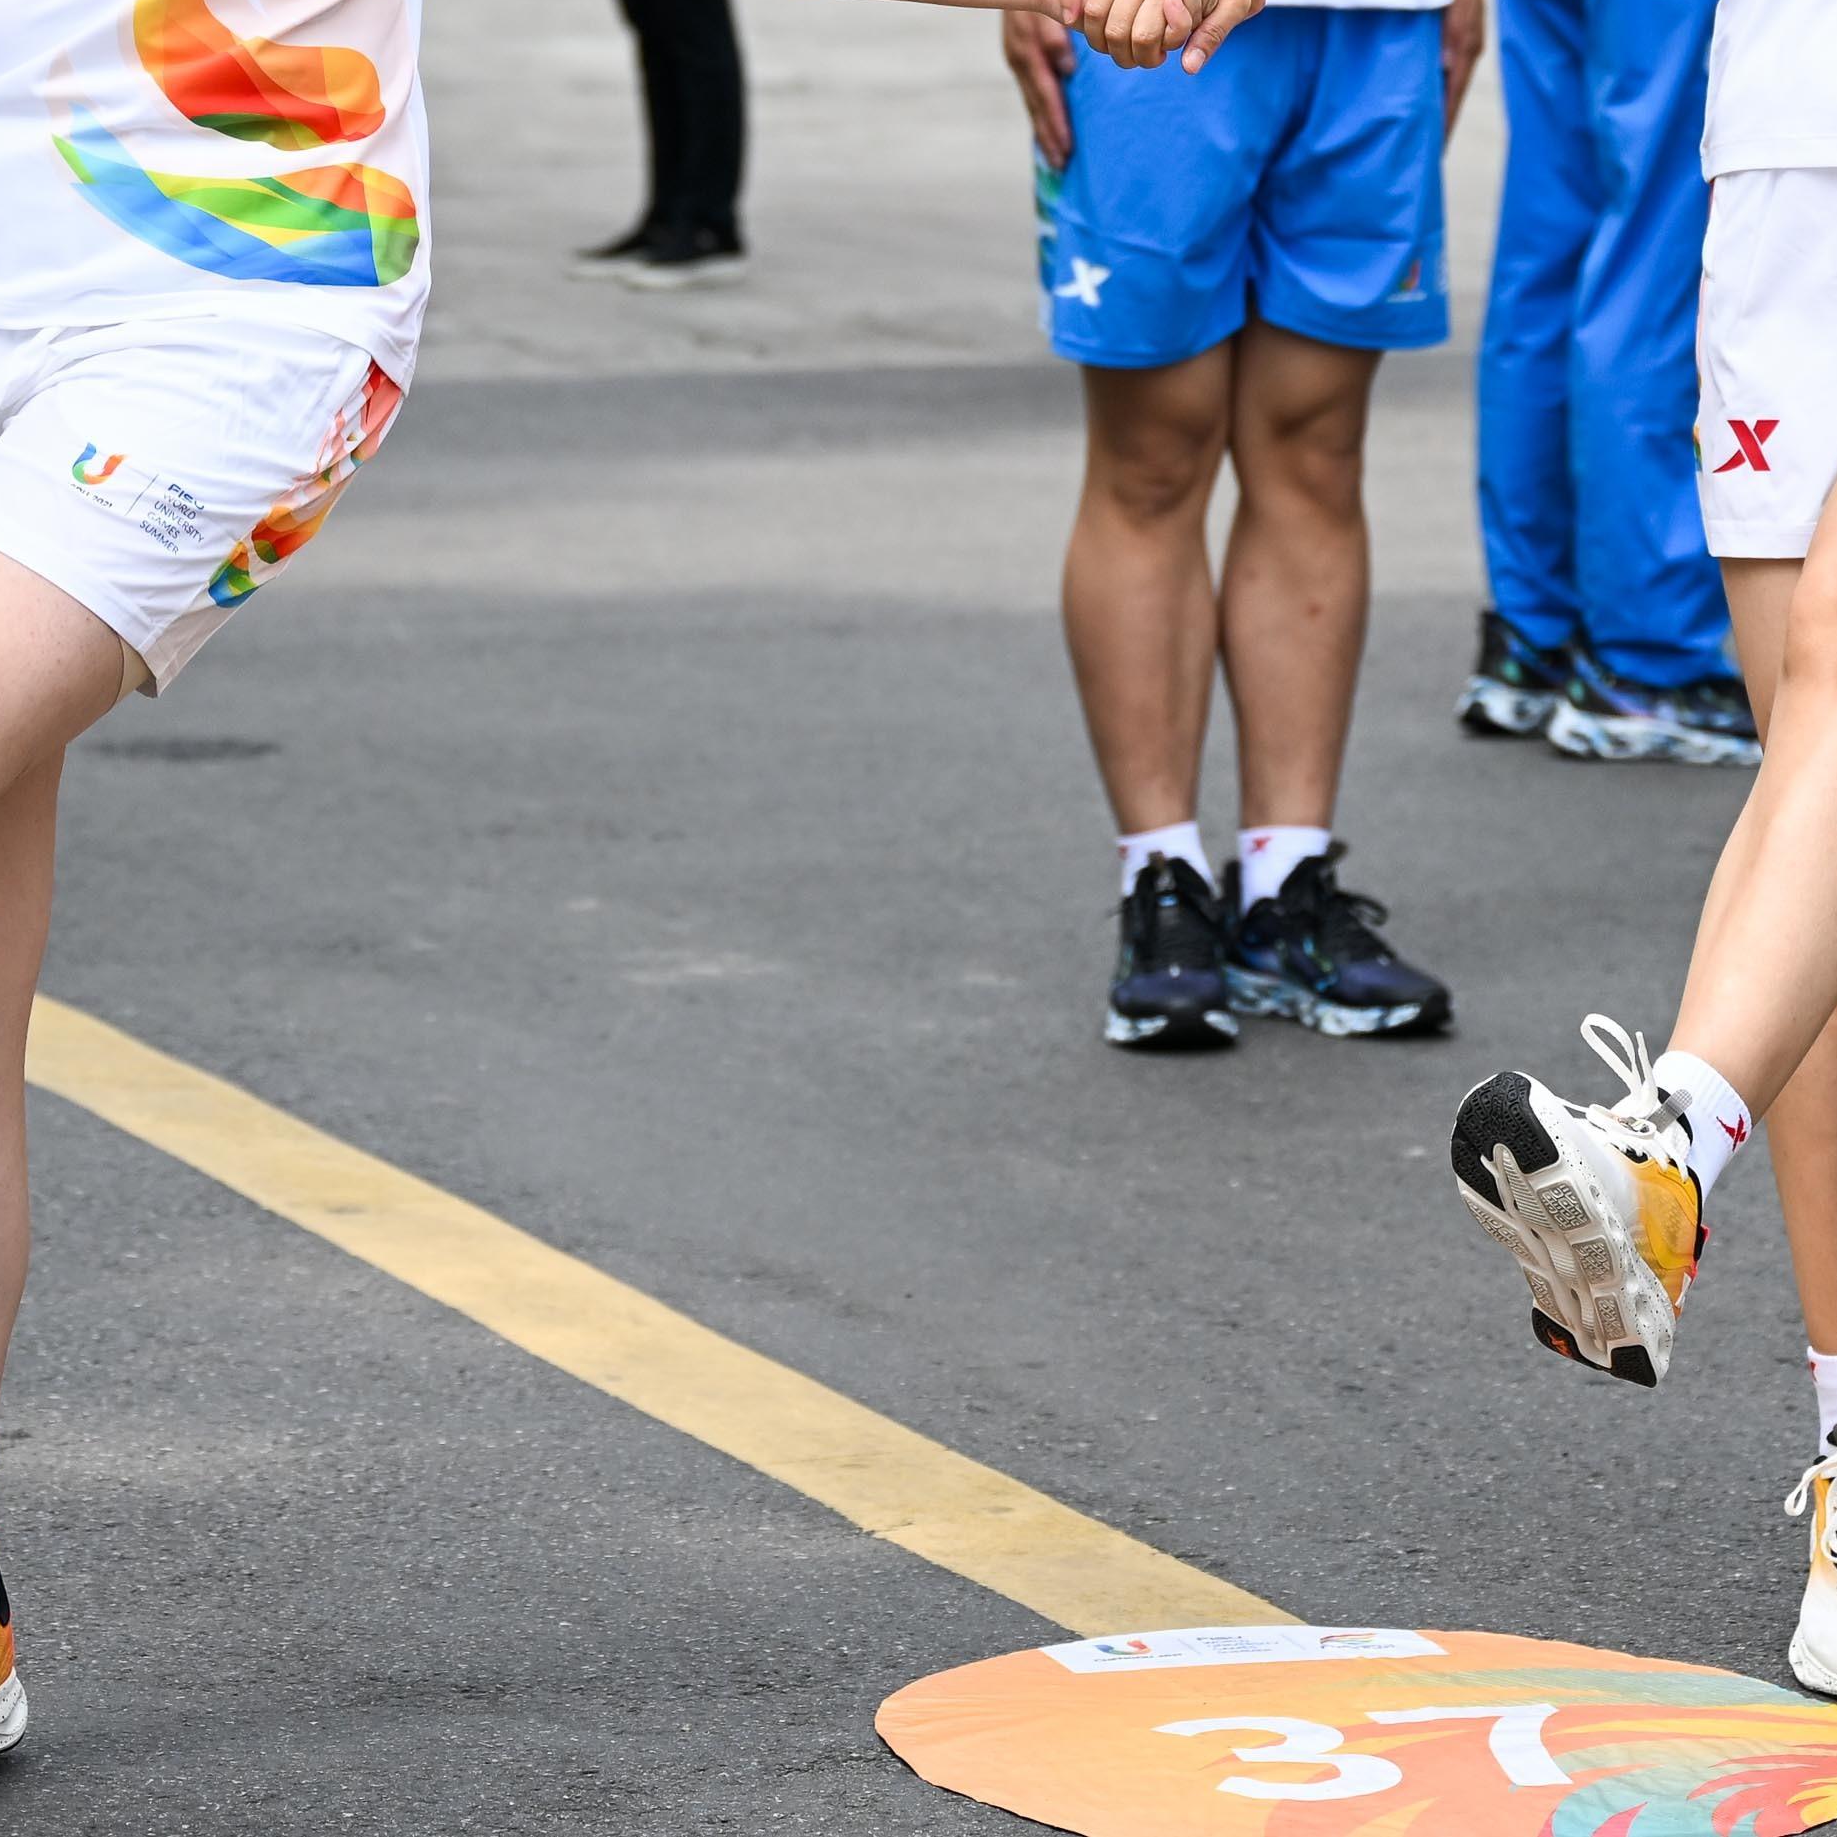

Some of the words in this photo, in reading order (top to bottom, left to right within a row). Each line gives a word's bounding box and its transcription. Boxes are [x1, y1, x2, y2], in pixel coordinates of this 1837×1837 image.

[139, 520, 179, 555] SUMMER
[154, 500, 205, 543] UNIVERSITY
[1150, 1703, 1573, 1801] 37
